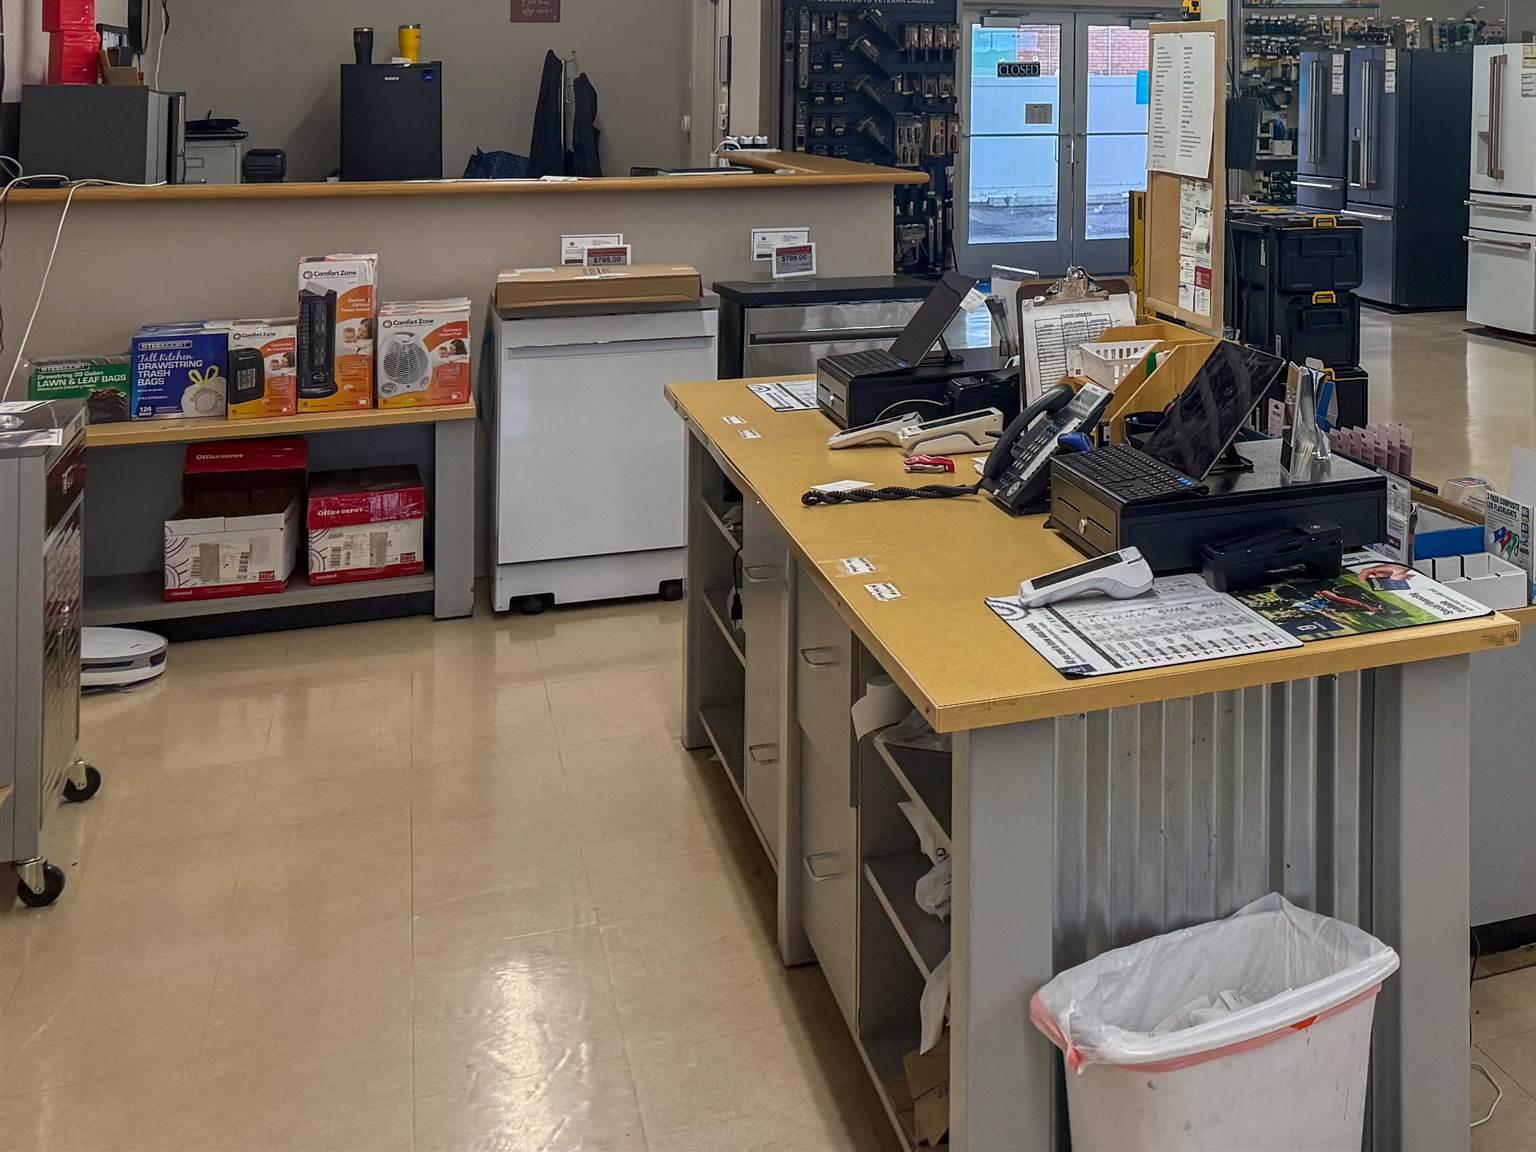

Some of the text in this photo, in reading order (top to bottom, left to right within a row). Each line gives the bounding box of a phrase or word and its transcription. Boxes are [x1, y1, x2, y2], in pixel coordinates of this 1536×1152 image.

[999, 64, 1040, 76] CLOSED
[314, 269, 357, 278] Comfort Zone
[393, 317, 434, 327] Comfort Zone
[241, 331, 262, 339] Comfort
[138, 350, 194, 362] Tall Kitchen
[137, 359, 203, 371] DRAWSTRING
[138, 369, 171, 379] TRASH
[37, 378, 67, 388] LAWN
[68, 377, 76, 385] &
[77, 376, 100, 385] LEAF
[101, 374, 127, 383] BAGS
[138, 377, 165, 386] BAGS
[317, 509, 340, 517] Office
